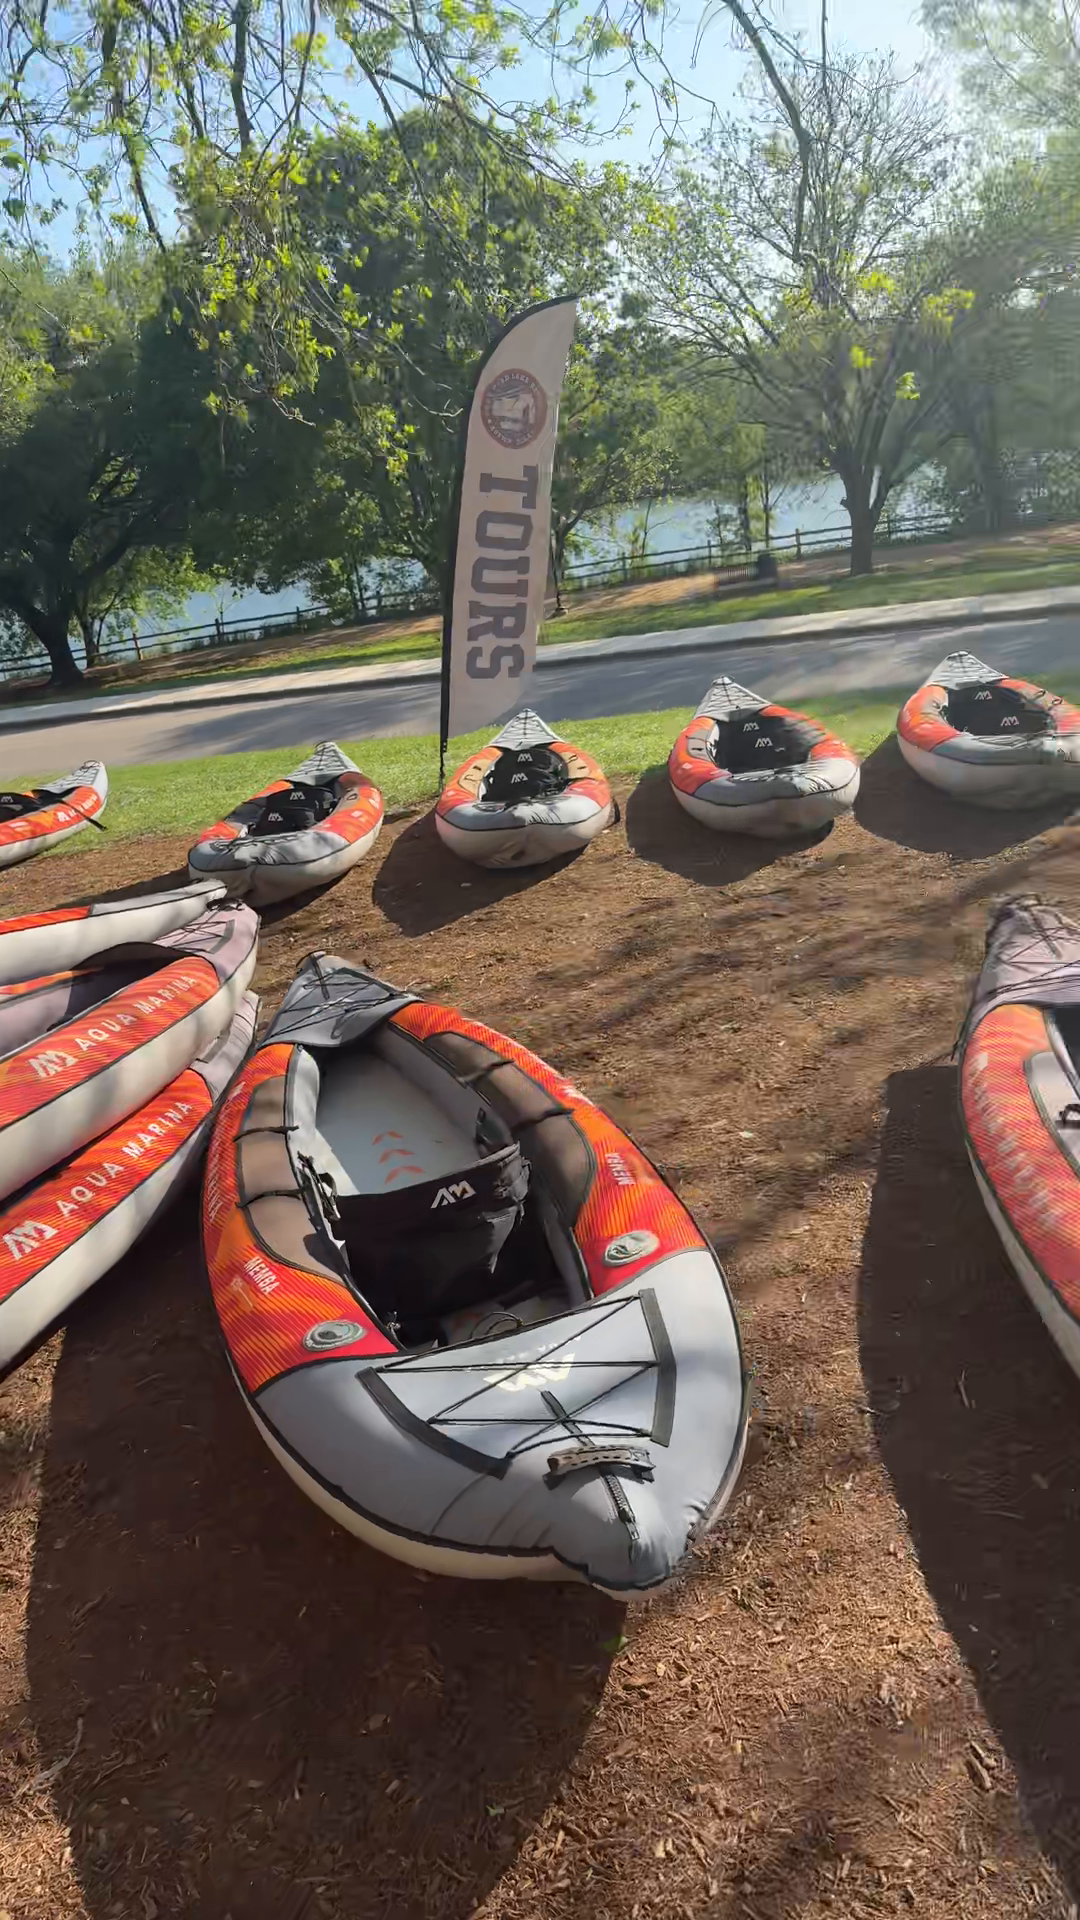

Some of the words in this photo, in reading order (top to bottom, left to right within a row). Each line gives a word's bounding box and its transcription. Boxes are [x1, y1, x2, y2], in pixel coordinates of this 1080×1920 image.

[466, 465, 538, 679] TOURS
[74, 1013, 137, 1051] AQUA
[133, 975, 197, 1014] MARINA
[55, 1162, 124, 1217] AQUA
[122, 1102, 193, 1159] MARINA
[244, 1256, 280, 1295] MEMBA
